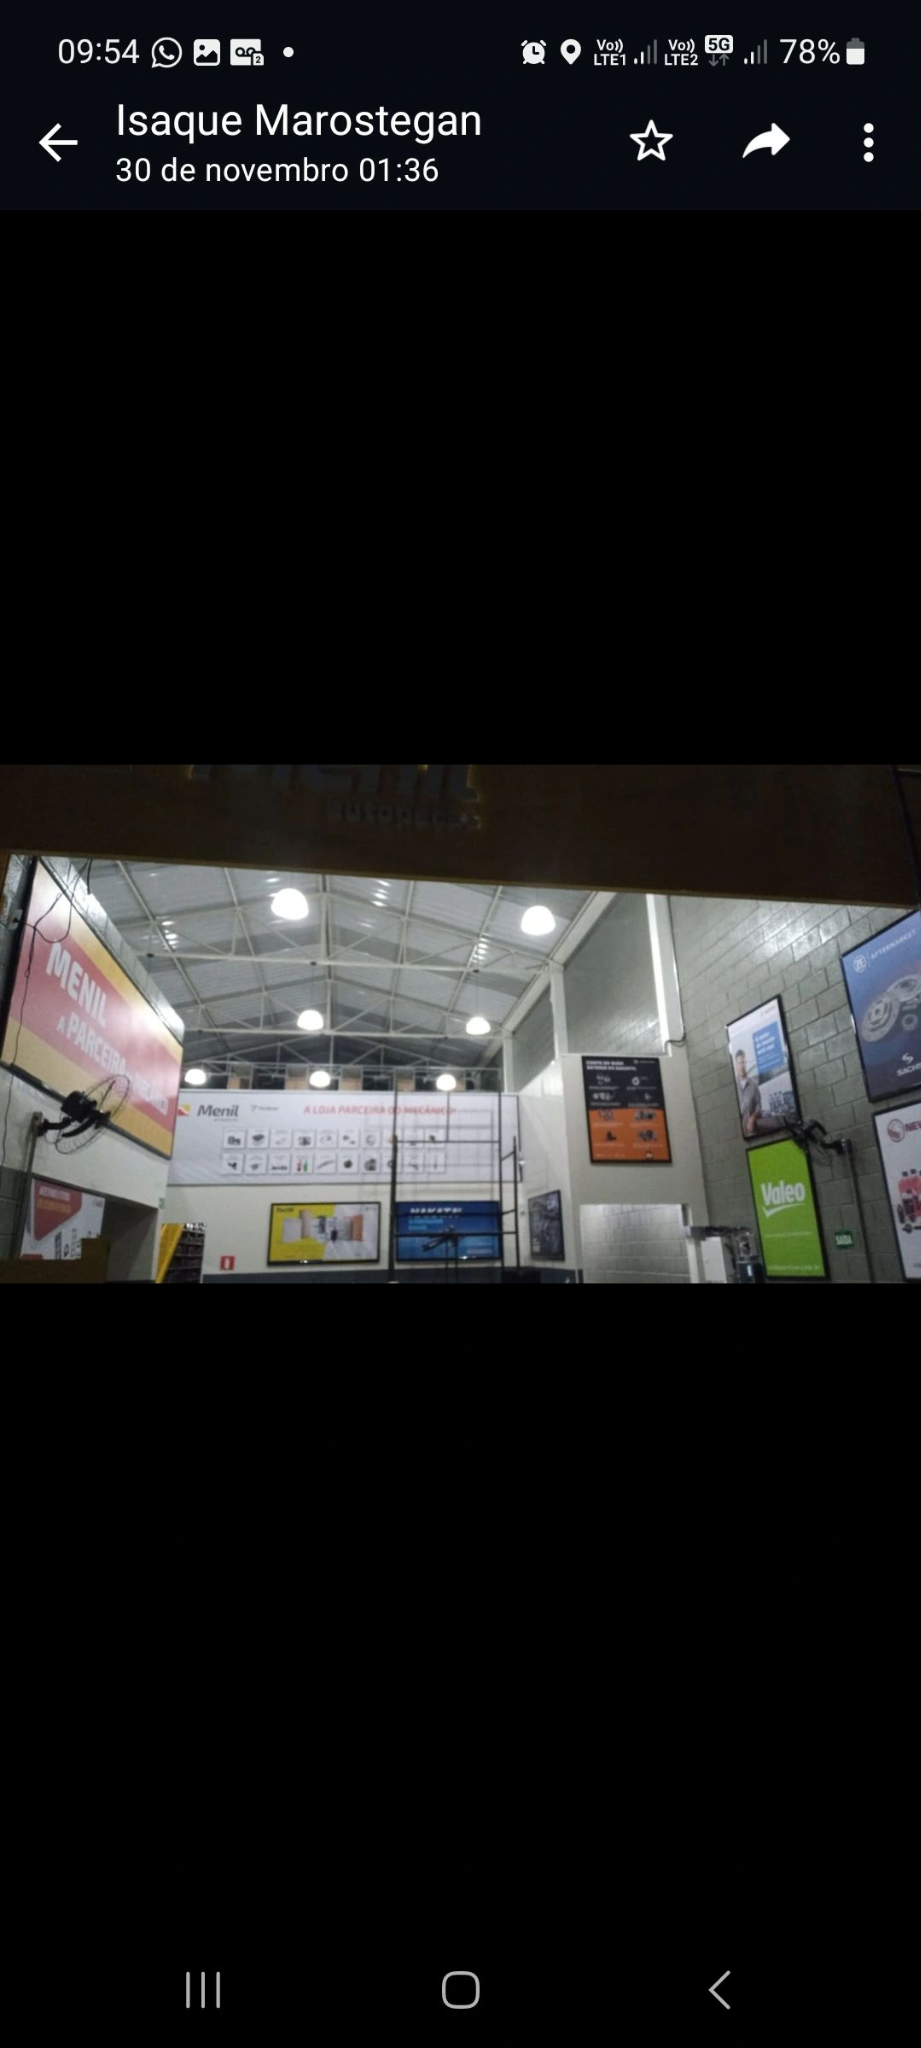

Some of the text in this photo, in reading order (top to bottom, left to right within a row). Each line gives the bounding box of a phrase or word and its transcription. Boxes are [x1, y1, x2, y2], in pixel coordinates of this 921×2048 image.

[45, 938, 108, 1027] MENIL
[56, 1012, 127, 1075] A PARCEIRA
[196, 1104, 240, 1117] Menil
[303, 1105, 311, 1115] A
[313, 1105, 336, 1115] LOJA
[338, 1105, 386, 1115] PARCEIRA
[388, 1105, 401, 1115] DO
[760, 1179, 806, 1206] Valeo
